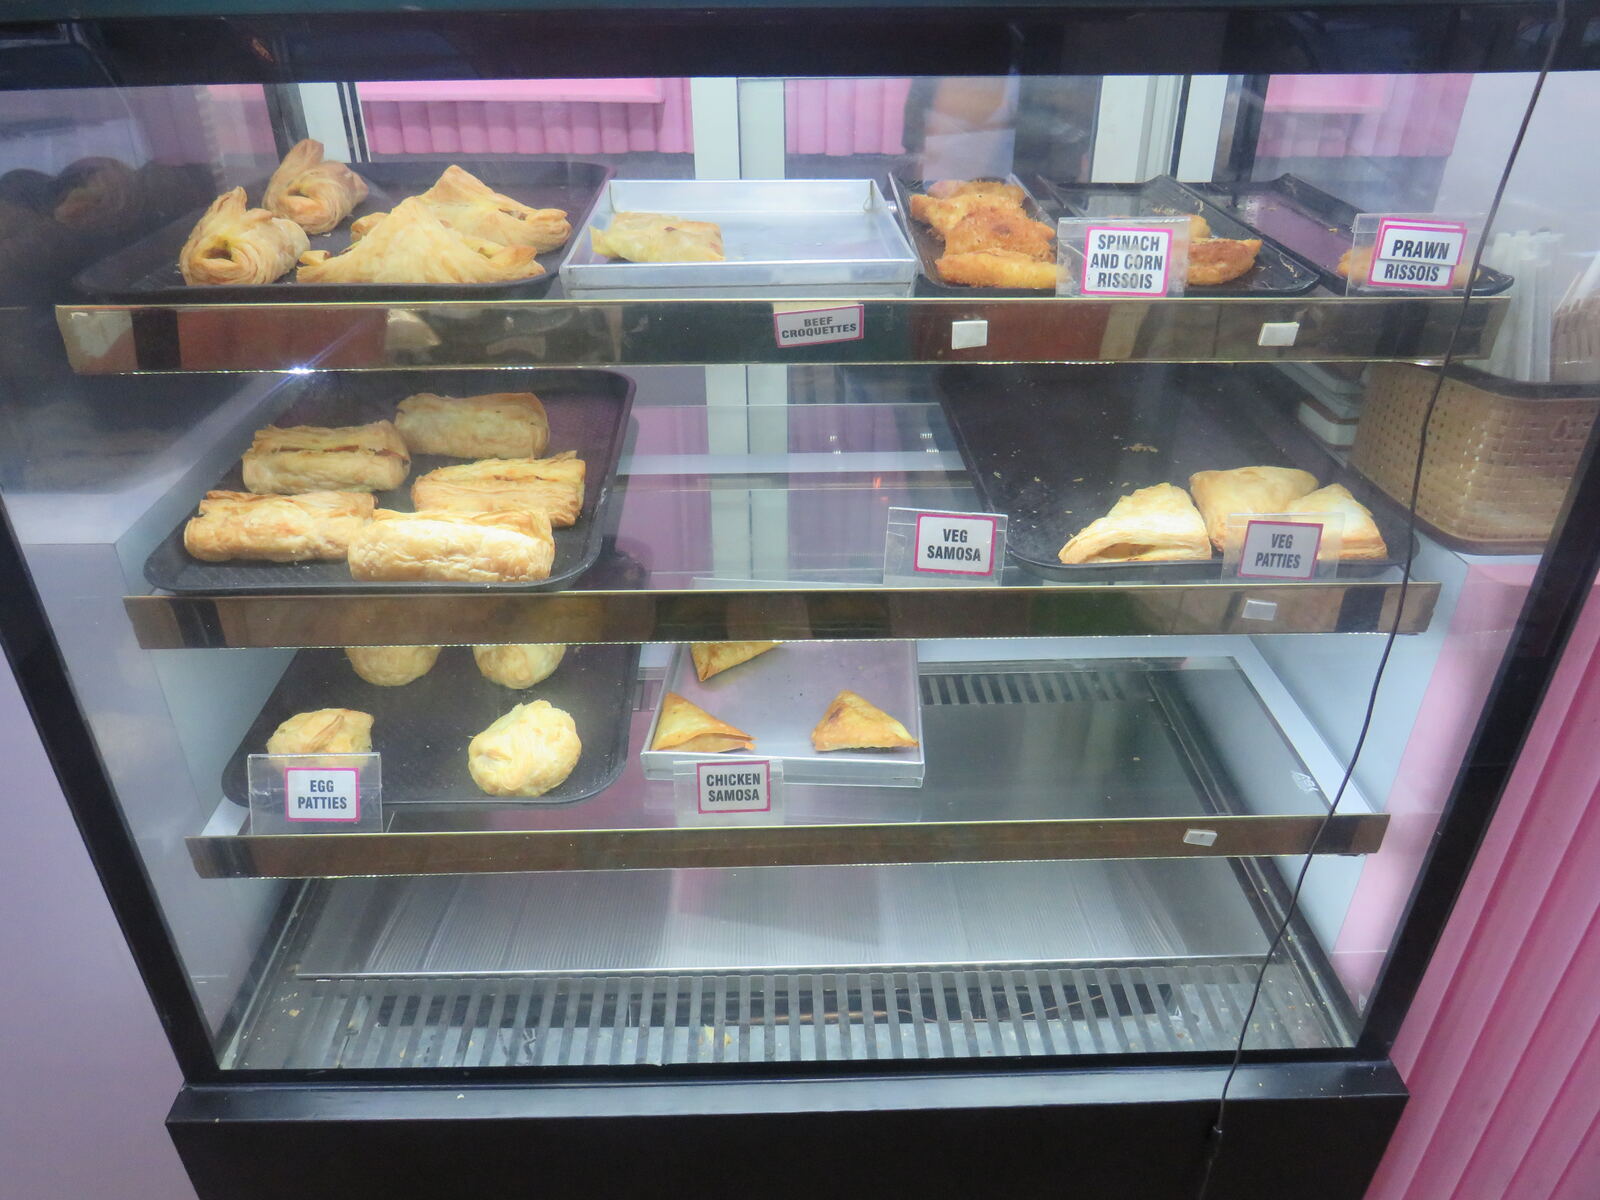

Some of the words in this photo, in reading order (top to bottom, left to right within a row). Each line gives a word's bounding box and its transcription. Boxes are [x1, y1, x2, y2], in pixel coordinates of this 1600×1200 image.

[1098, 234, 1160, 252] SPINACH
[1391, 239, 1450, 259] PRAWN
[1090, 253, 1119, 269] AND
[1124, 254, 1163, 270] CORN
[1097, 272, 1153, 289] RISSOIS
[1384, 263, 1440, 282] RISSOIS
[804, 316, 833, 327] BEEF
[781, 323, 857, 339] CROQUETTES
[942, 528, 968, 543] VEG
[1271, 533, 1294, 549] VEG
[927, 545, 981, 561] SAMOSA
[1255, 552, 1302, 569] PATTIES
[310, 779, 334, 793] EGG
[706, 773, 761, 786] CHICKEN
[297, 796, 347, 810] PATTIES
[708, 789, 760, 802] SAMOSA
